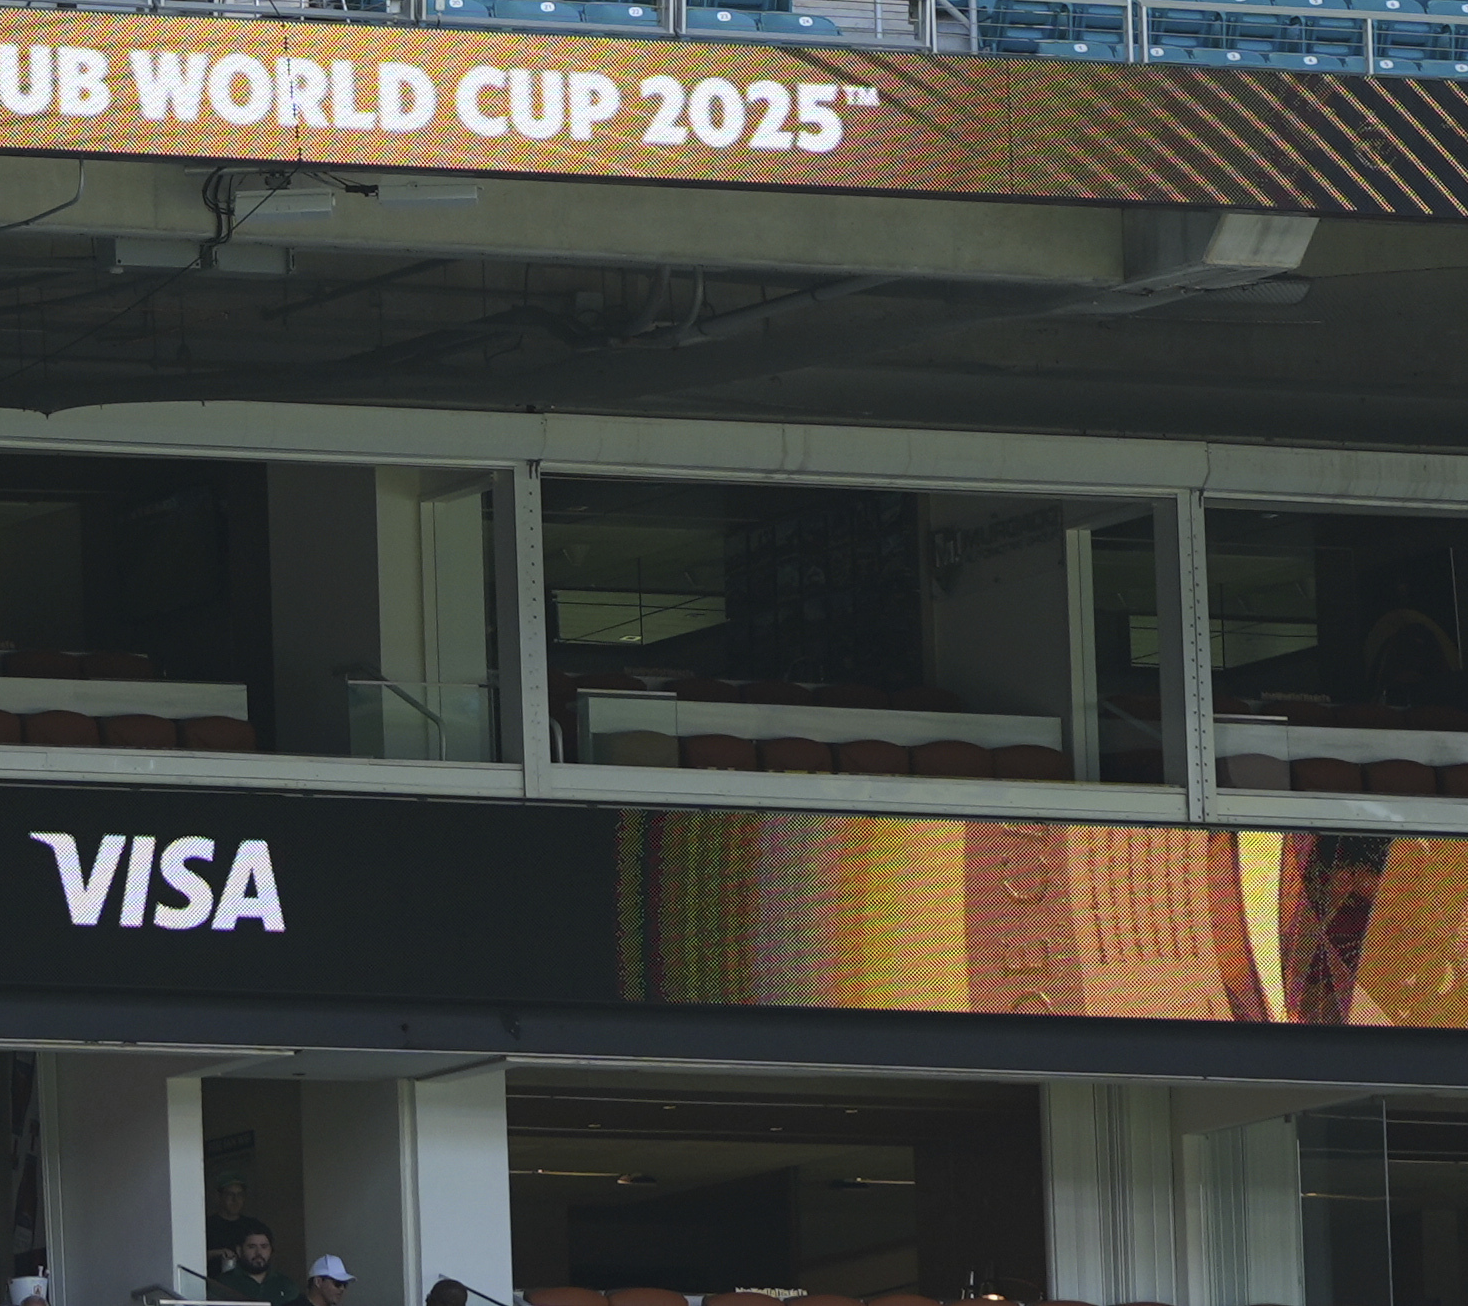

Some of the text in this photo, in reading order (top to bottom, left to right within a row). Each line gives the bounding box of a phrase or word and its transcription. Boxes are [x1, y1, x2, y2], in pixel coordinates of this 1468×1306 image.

[129, 50, 437, 133] WORLD
[455, 65, 621, 140] CUP
[31, 833, 285, 931] VISA
